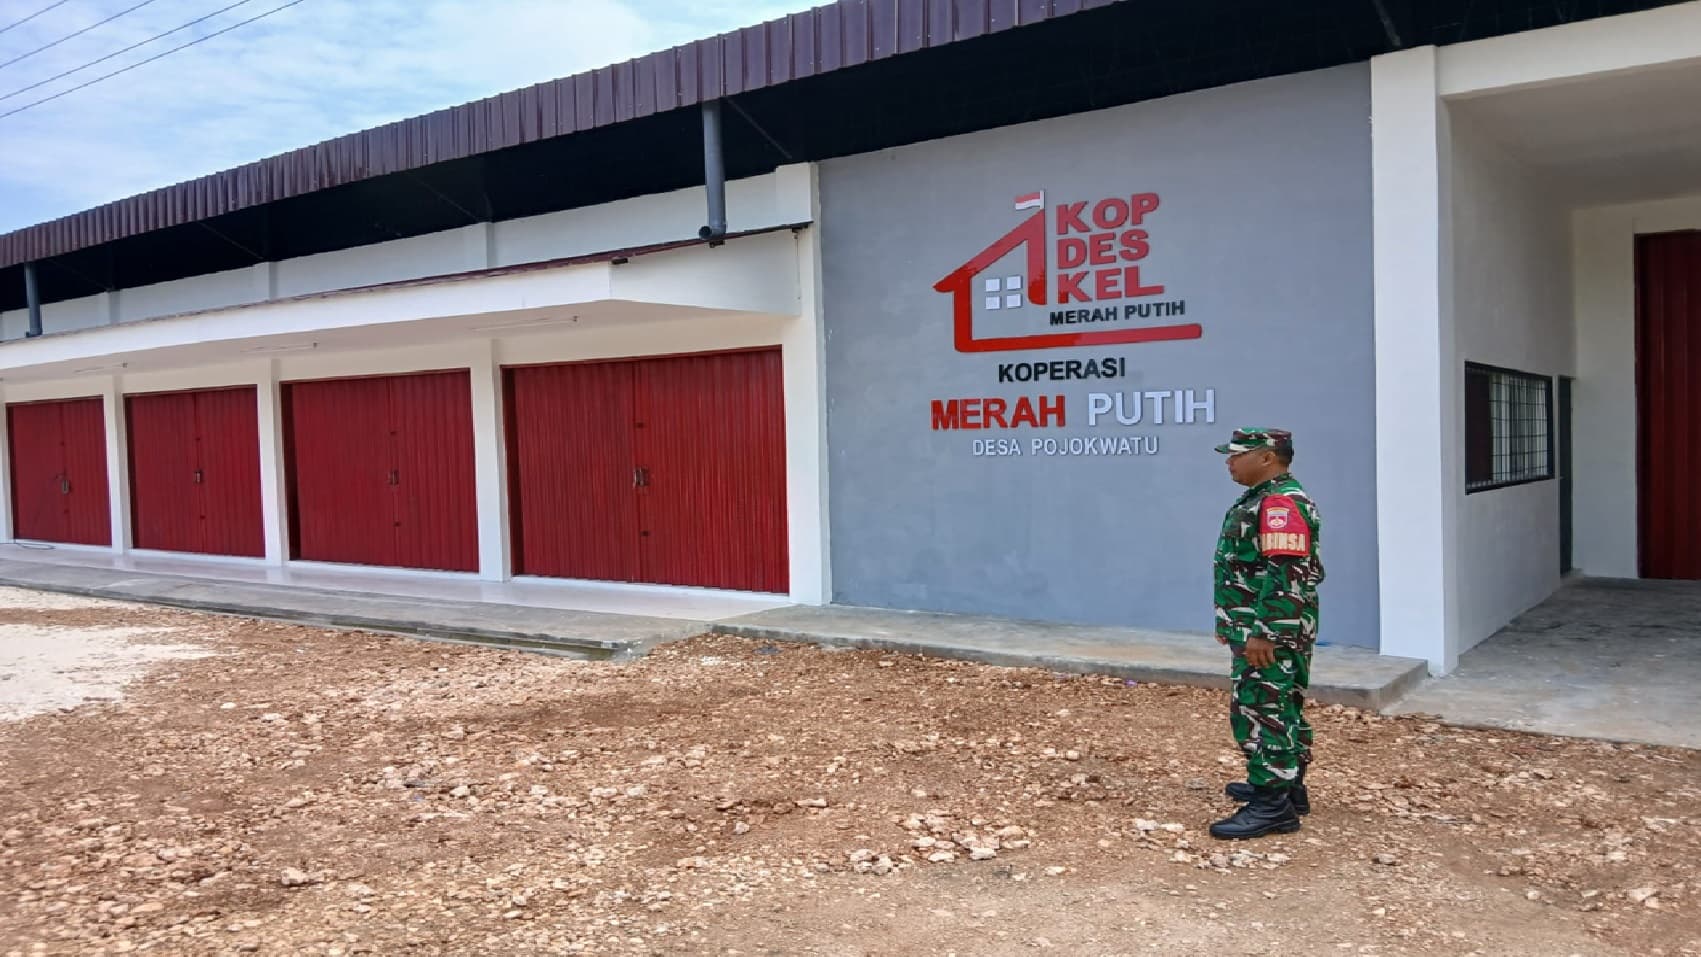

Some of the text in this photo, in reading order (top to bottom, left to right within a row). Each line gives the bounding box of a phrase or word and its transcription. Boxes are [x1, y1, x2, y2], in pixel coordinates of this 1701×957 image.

[1056, 193, 1159, 235] KOP
[1057, 229, 1150, 269] DES
[1057, 266, 1165, 304] KEL
[1049, 300, 1186, 326] MERAH PUTIH
[998, 357, 1126, 382] KOPERASI
[930, 389, 1215, 431] MERAH PUTIH
[972, 436, 1159, 456] DESA POJOKWATU
